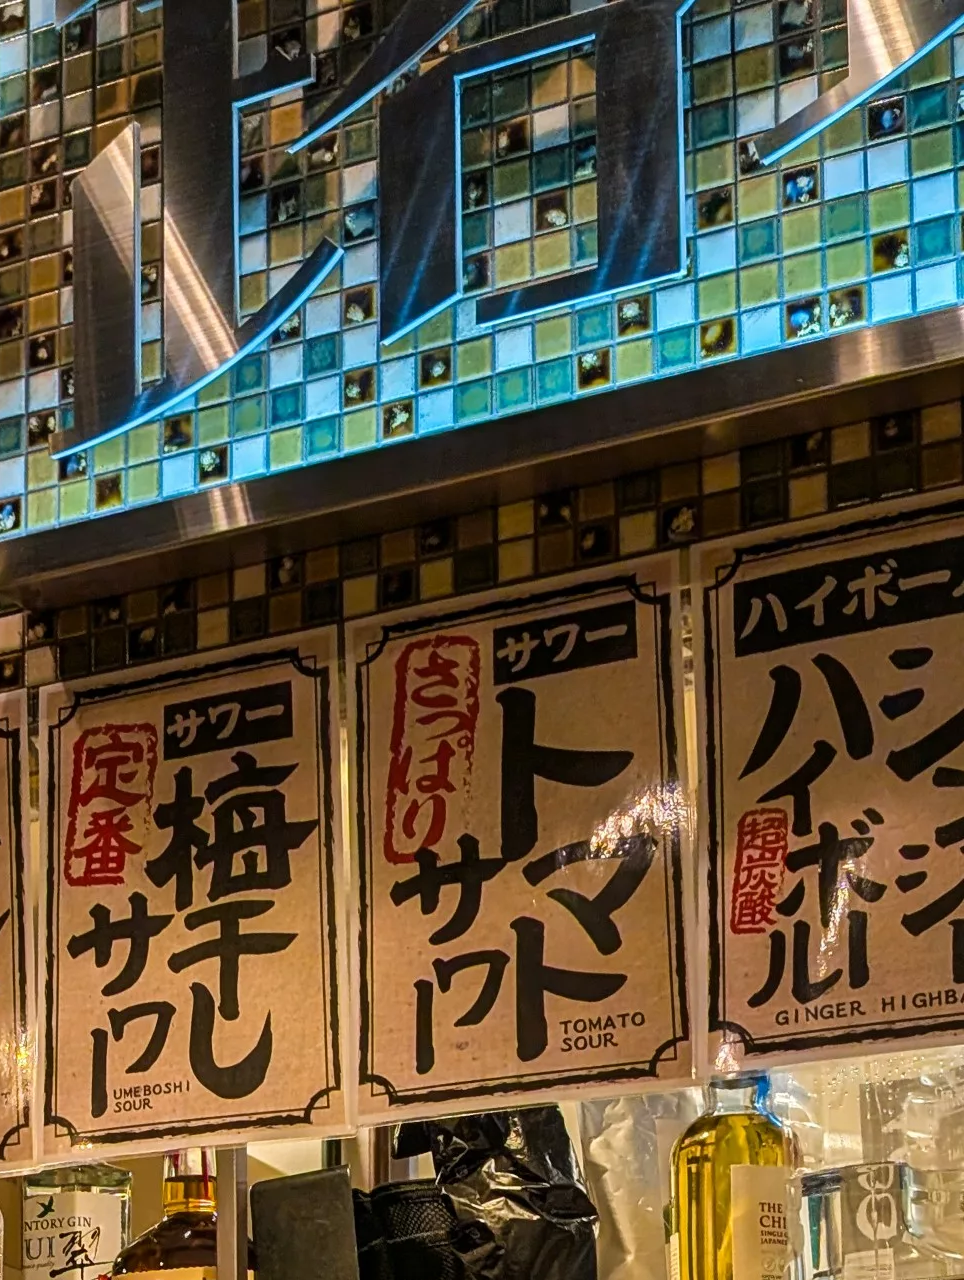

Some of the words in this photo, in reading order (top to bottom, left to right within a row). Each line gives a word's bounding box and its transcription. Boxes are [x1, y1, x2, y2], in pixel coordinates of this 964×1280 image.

[739, 558, 964, 641] ハイボー
[496, 622, 628, 670] サワー
[166, 701, 286, 748] サワー
[388, 641, 477, 858] さっぱり
[69, 726, 152, 885] 定番
[501, 687, 658, 1063] トマト
[146, 752, 319, 1100] 梅干し
[390, 835, 512, 1075] サワー
[66, 891, 176, 1119] サワー
[560, 1010, 647, 1035] TOMATO
[775, 1000, 866, 1026] GINGER
[561, 1031, 620, 1053] SOUR
[112, 1079, 192, 1100] UMEBOSHI
[113, 1097, 155, 1114] SOUR
[67, 1216, 92, 1228] GIN
[759, 1202, 783, 1214] THE
